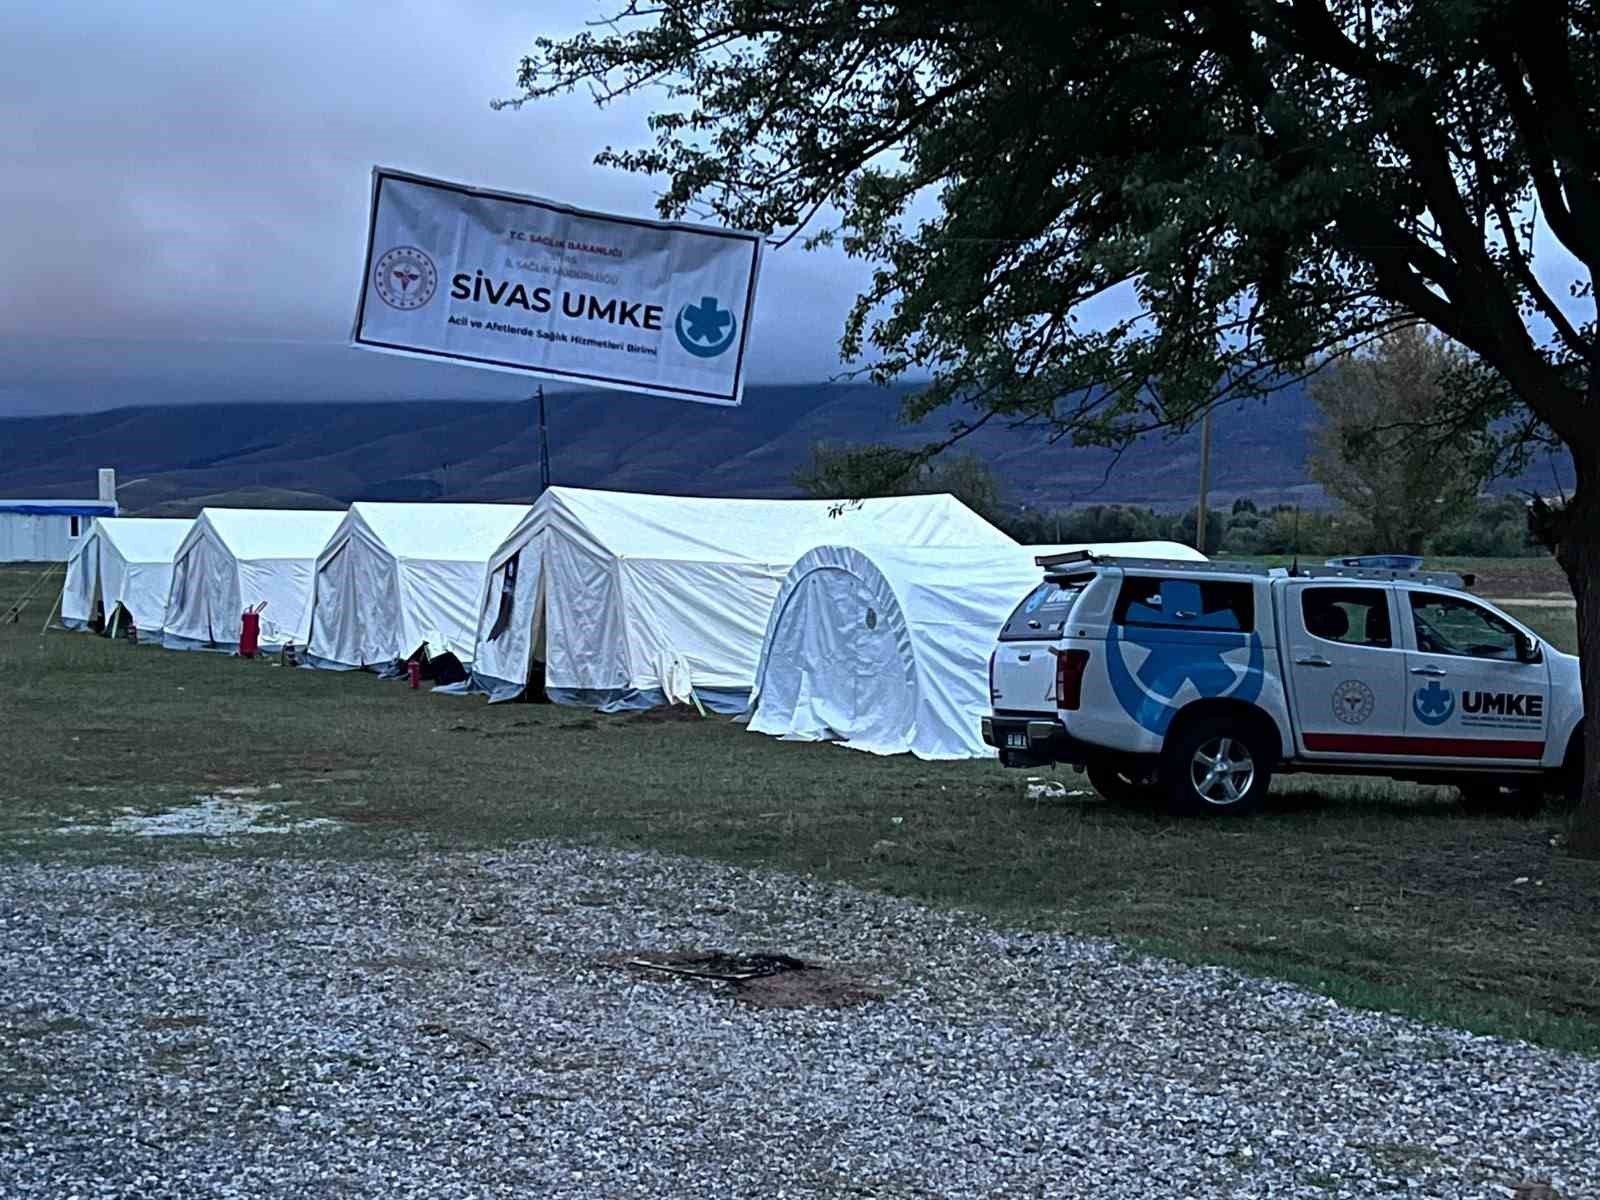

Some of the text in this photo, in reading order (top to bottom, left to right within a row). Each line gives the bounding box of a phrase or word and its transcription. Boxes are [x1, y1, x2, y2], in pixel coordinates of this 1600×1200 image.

[450, 269, 664, 331] SİVAS UMKE
[448, 315, 657, 356] Acil ve Afetlerde Sağlık Hizmetleri Birimi
[1462, 691, 1543, 717] UMKE
